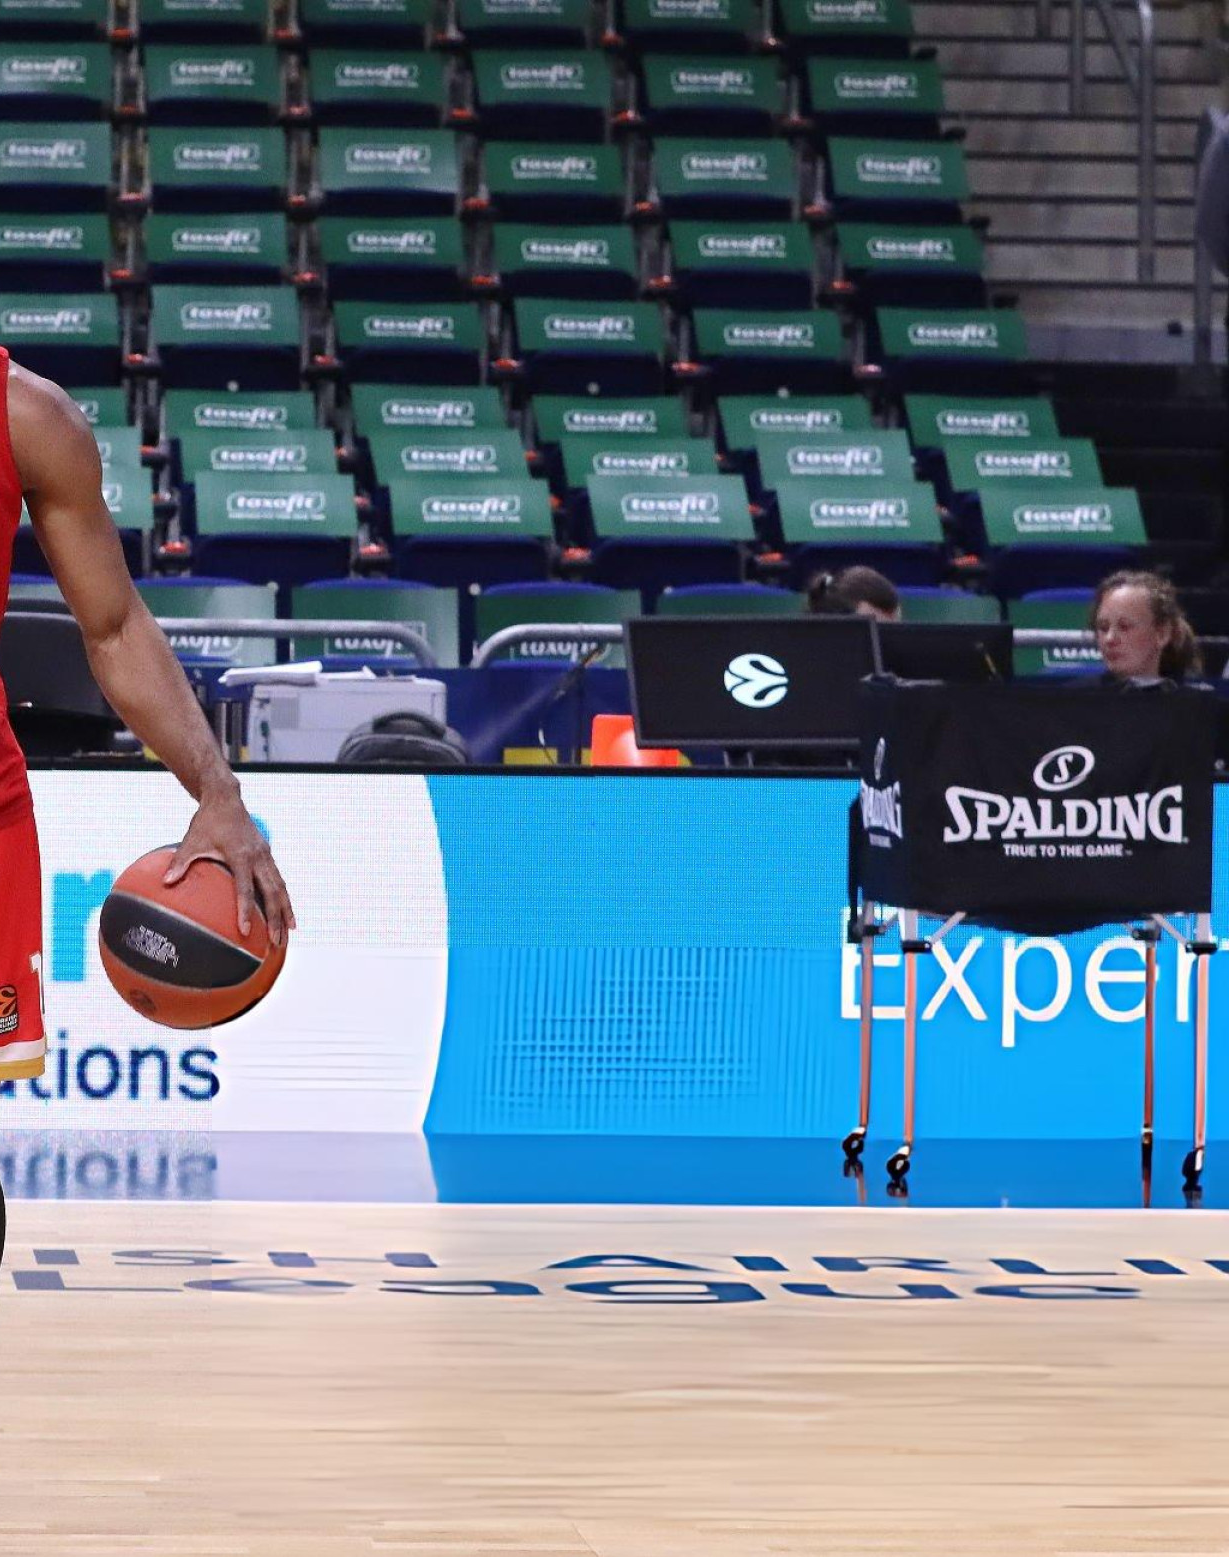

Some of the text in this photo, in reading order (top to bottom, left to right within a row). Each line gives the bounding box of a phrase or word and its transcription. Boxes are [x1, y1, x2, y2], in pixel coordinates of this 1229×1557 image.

[943, 785, 1183, 844] SPALDING
[1003, 843, 1124, 858] TRUE TO THE GAME
[841, 907, 1229, 1048] Exper
